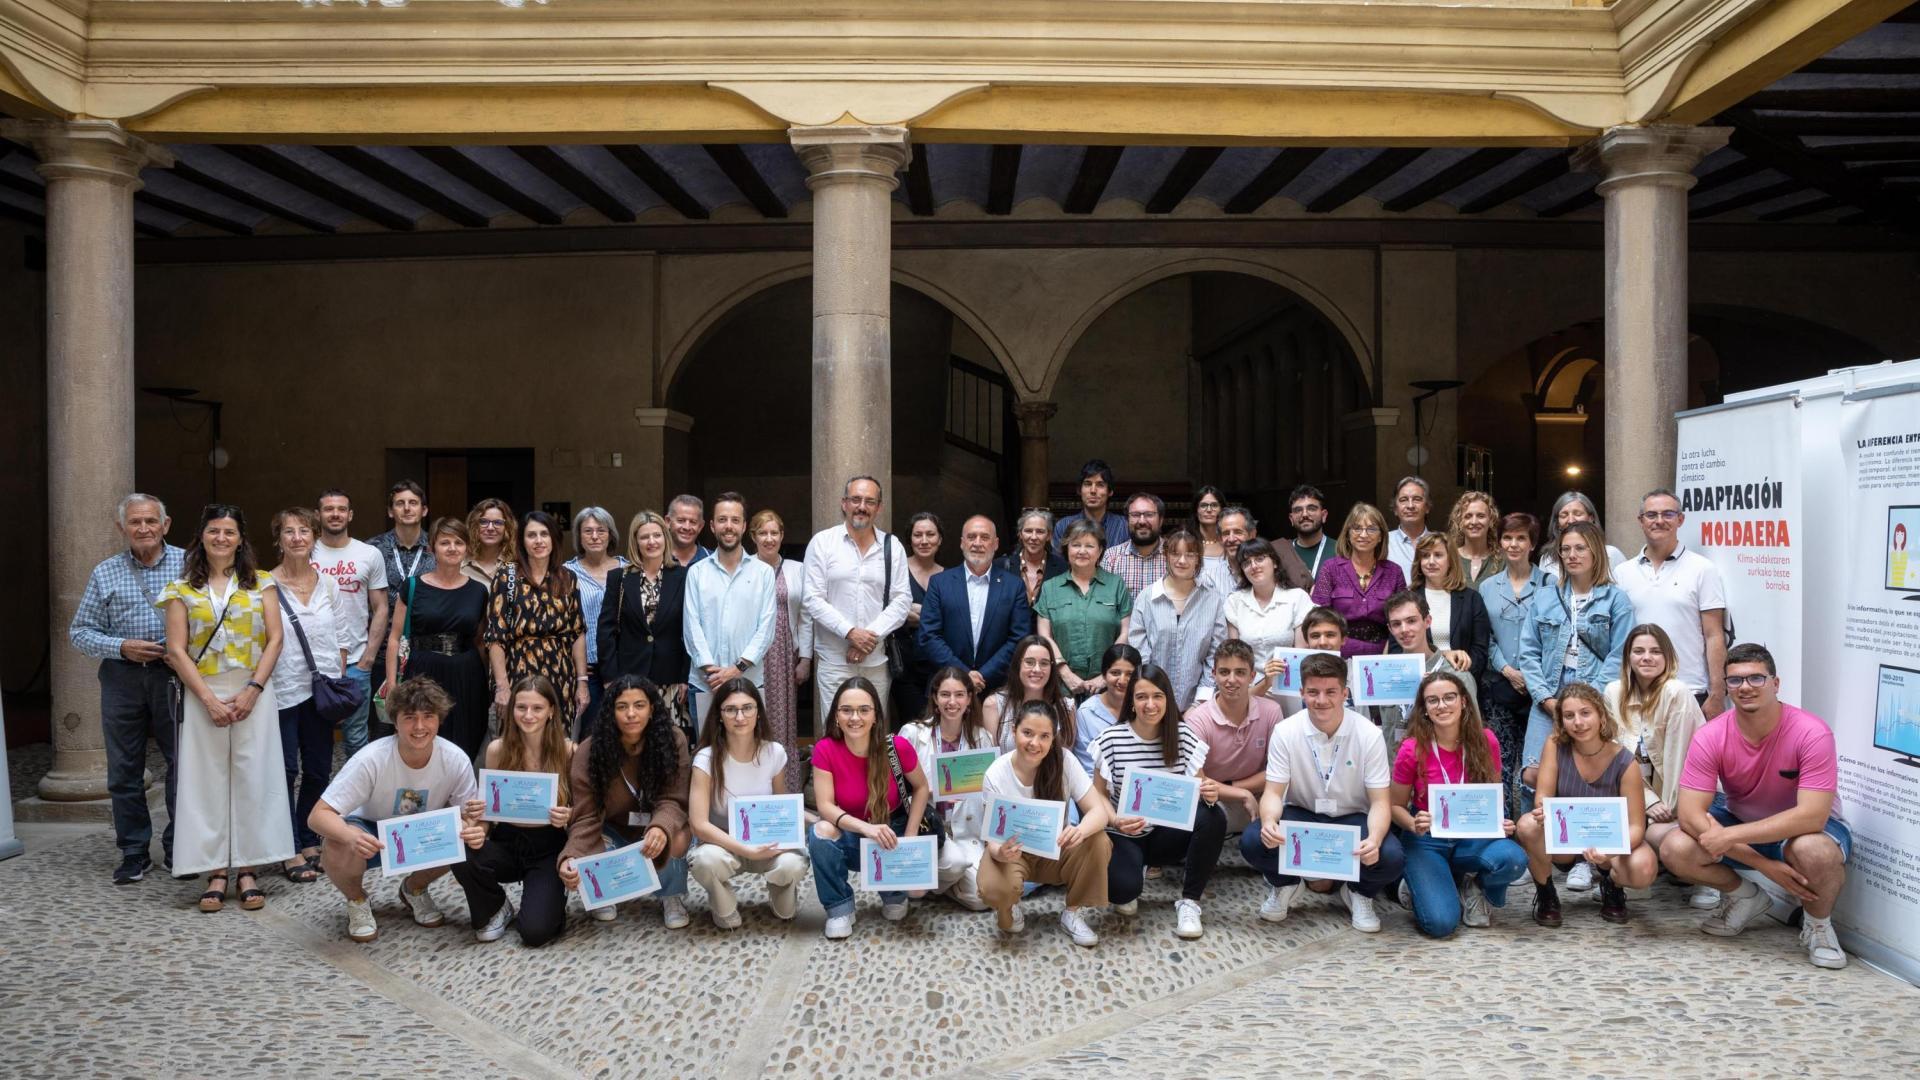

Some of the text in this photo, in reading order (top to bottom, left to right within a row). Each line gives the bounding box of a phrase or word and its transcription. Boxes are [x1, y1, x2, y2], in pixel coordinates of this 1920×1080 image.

[1857, 440, 1866, 448] LA
[1681, 449, 1716, 460] La otra lucha
[1700, 461, 1705, 469] el
[1706, 459, 1726, 469] cambio
[1681, 474, 1705, 482] climático
[1682, 476, 1782, 512] ADAPTACIÓN
[1701, 520, 1790, 547] MOLDAERA
[1766, 583, 1790, 591] borroka
[1877, 766, 1885, 774] los
[1886, 768, 1919, 784] informativos
[1902, 849, 1913, 861] hoy
[1899, 860, 1915, 871] clima
[1896, 879, 1906, 889] De
[1888, 888, 1898, 897] que
[1899, 893, 1918, 905] vamos
